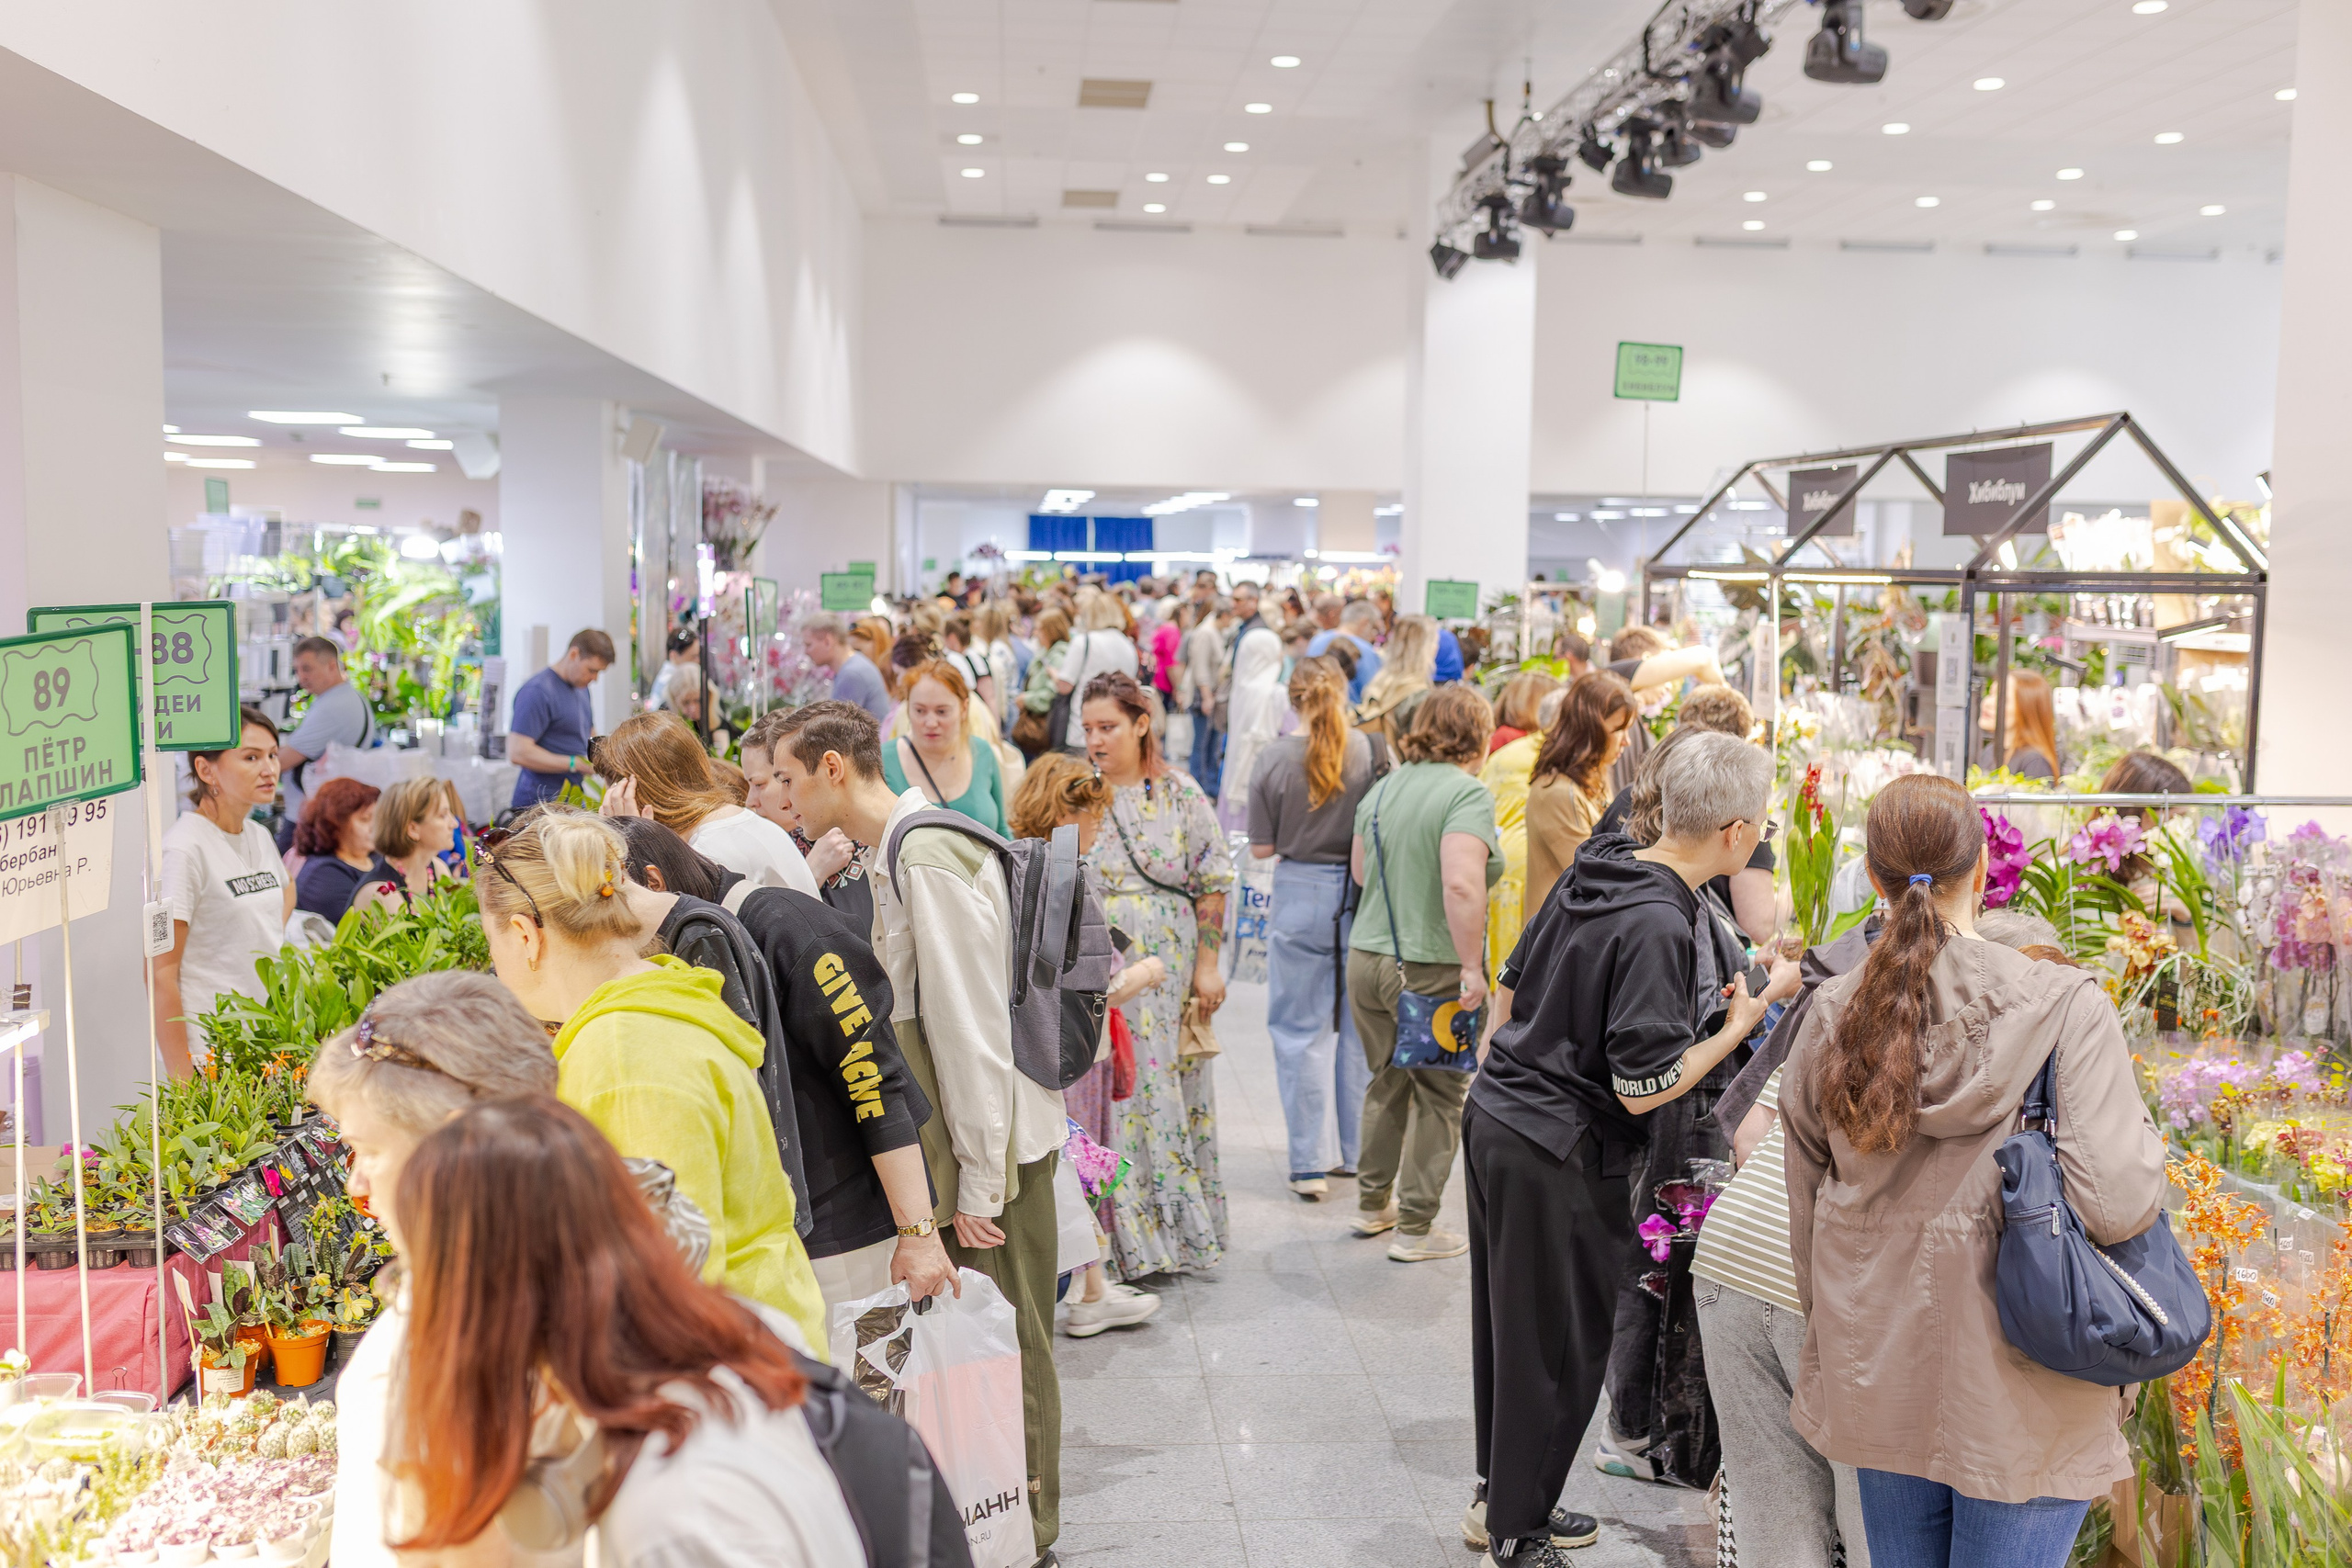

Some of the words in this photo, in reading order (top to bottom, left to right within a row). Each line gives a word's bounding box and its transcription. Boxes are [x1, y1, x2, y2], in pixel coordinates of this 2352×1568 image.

[33, 667, 71, 712] 89
[24, 737, 86, 773] ПЁТР
[0, 759, 113, 809] ЛАПШИН
[17, 814, 46, 840] 191
[85, 798, 107, 823] 95
[232, 878, 250, 895] NO
[813, 952, 874, 1037] GIVE
[1611, 1073, 1657, 1096] WORLD
[967, 1529, 991, 1547] N.RU
